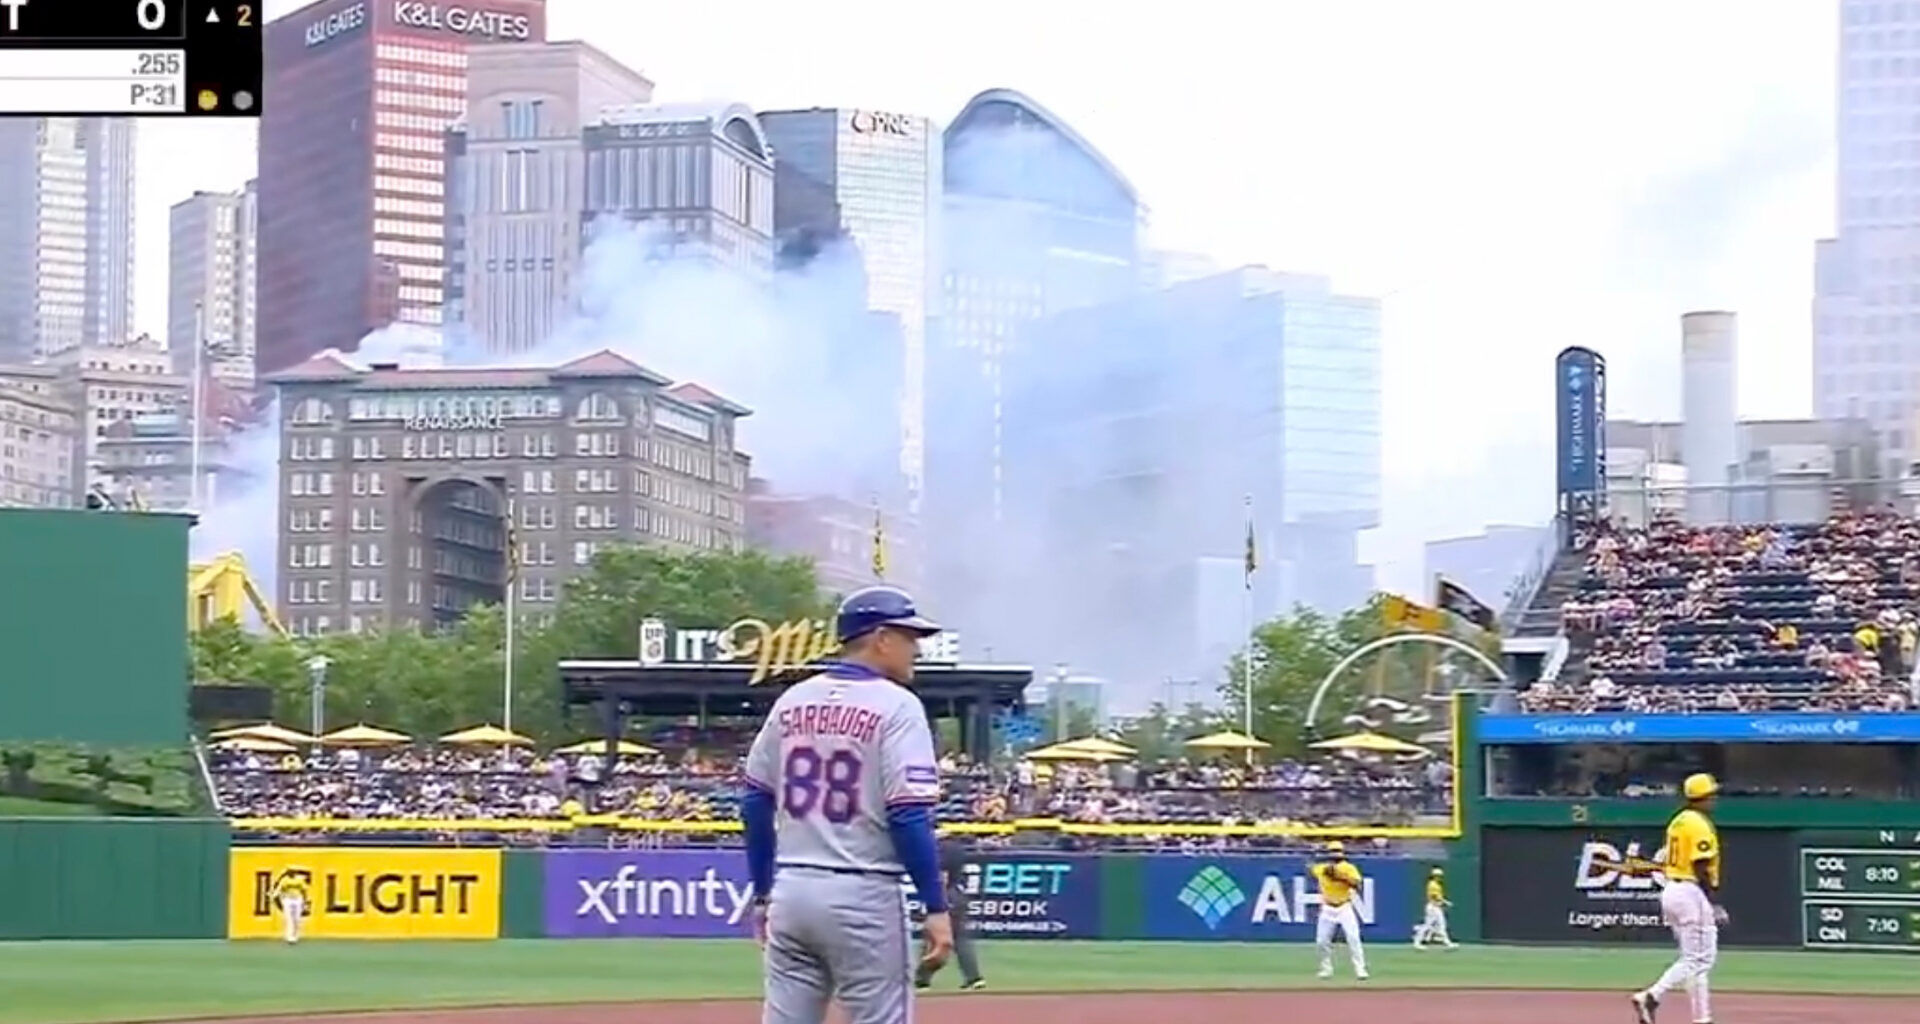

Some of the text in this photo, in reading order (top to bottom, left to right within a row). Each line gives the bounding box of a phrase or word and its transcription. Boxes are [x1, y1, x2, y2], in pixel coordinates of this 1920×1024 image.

[305, 4, 366, 46] K&L GATES
[395, 2, 529, 39] K&L GATES
[404, 414, 505, 431] RENAISSANCE
[779, 704, 883, 742] SARBAUGH
[784, 746, 863, 824] 88
[1815, 857, 1848, 872] COL
[1865, 866, 1899, 882] 8:10
[983, 863, 1072, 895] BET
[1818, 876, 1845, 890] MIL
[325, 873, 479, 915] LIGHT
[576, 864, 755, 925] xfinity
[1568, 910, 1618, 929] Larger
[1622, 911, 1659, 926] than
[1820, 906, 1844, 922] SD
[1867, 917, 1900, 933] 7:10
